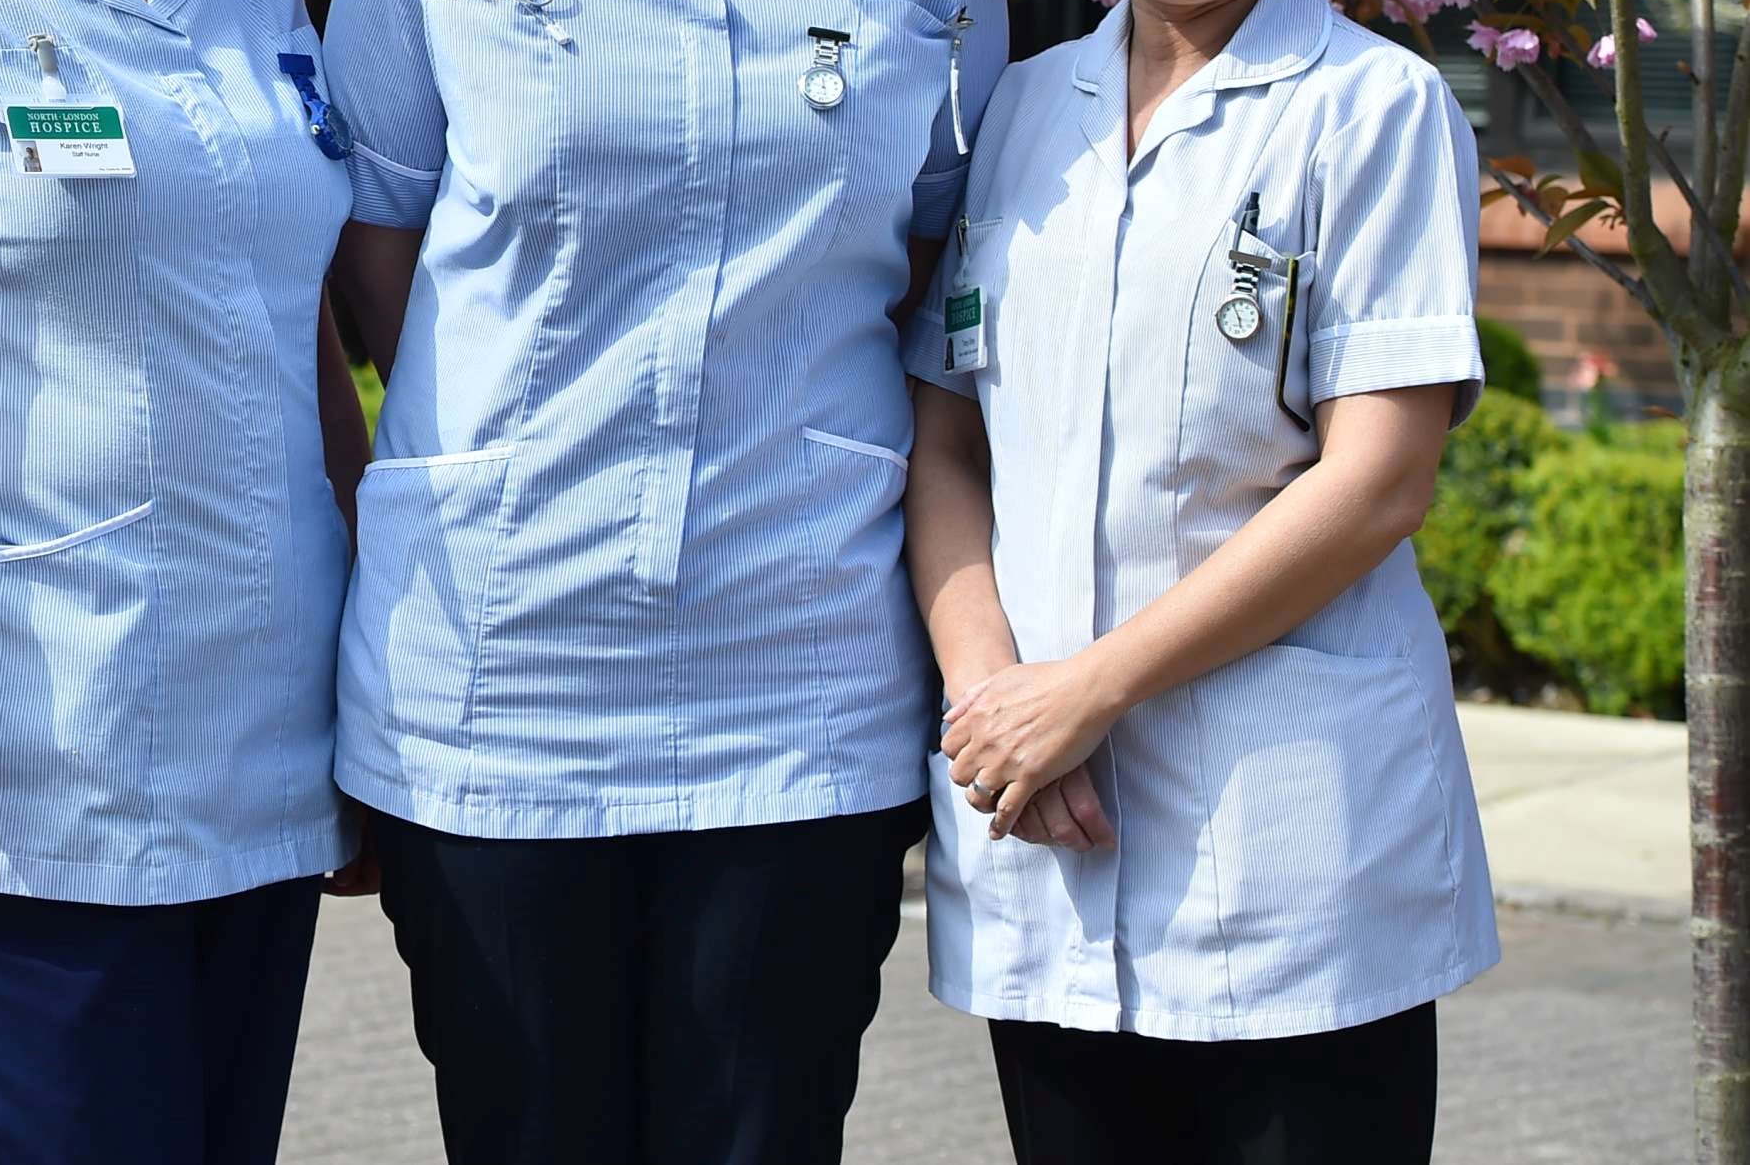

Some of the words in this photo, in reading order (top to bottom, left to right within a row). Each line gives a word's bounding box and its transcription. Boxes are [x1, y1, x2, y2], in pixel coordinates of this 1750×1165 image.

[27, 113, 58, 121] NORTH
[63, 113, 99, 121] LONDON
[30, 122, 102, 133] HOSPICE
[60, 142, 83, 150] Karen
[84, 142, 108, 151] Wright
